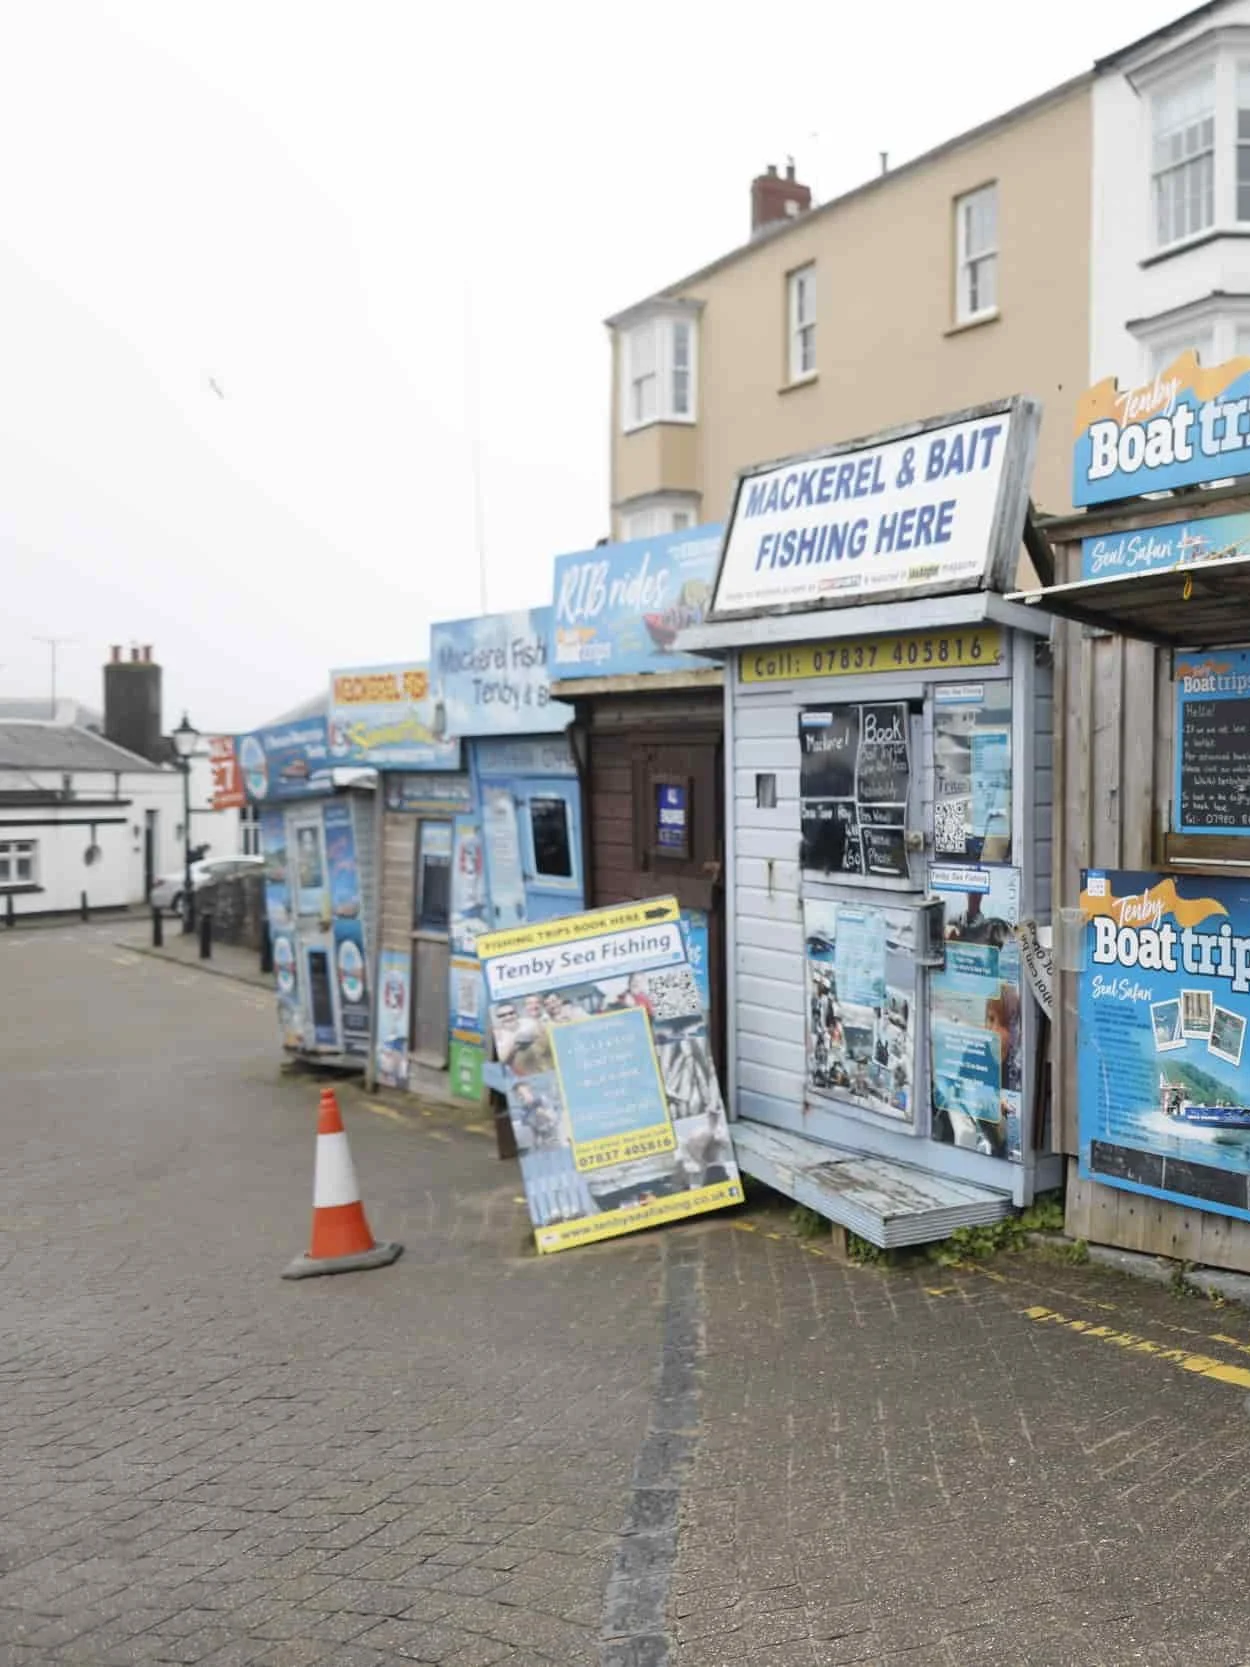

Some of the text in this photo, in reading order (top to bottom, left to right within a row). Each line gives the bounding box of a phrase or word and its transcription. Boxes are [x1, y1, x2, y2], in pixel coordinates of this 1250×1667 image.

[1115, 373, 1182, 427] Tenby
[1087, 403, 1194, 482] Boat
[745, 425, 1002, 518] MACKEREL & BAIT
[755, 517, 868, 572] FISHING
[874, 499, 956, 555] HERE
[1091, 535, 1173, 572] Seal Safari
[557, 560, 610, 624] RIB
[610, 551, 669, 610] rides
[754, 636, 982, 677] Call: 07837 405816
[473, 677, 519, 711] Tenby
[1182, 675, 1216, 694] Boat
[864, 713, 903, 743] Book
[537, 927, 571, 941] TRIPS
[573, 919, 607, 935] BOOK
[610, 912, 641, 926] HERE
[1113, 893, 1167, 929] Tenby
[495, 934, 671, 981] Tenby Sea Fishing
[1092, 916, 1182, 973] Boat
[1092, 974, 1152, 1003] Seal Safari
